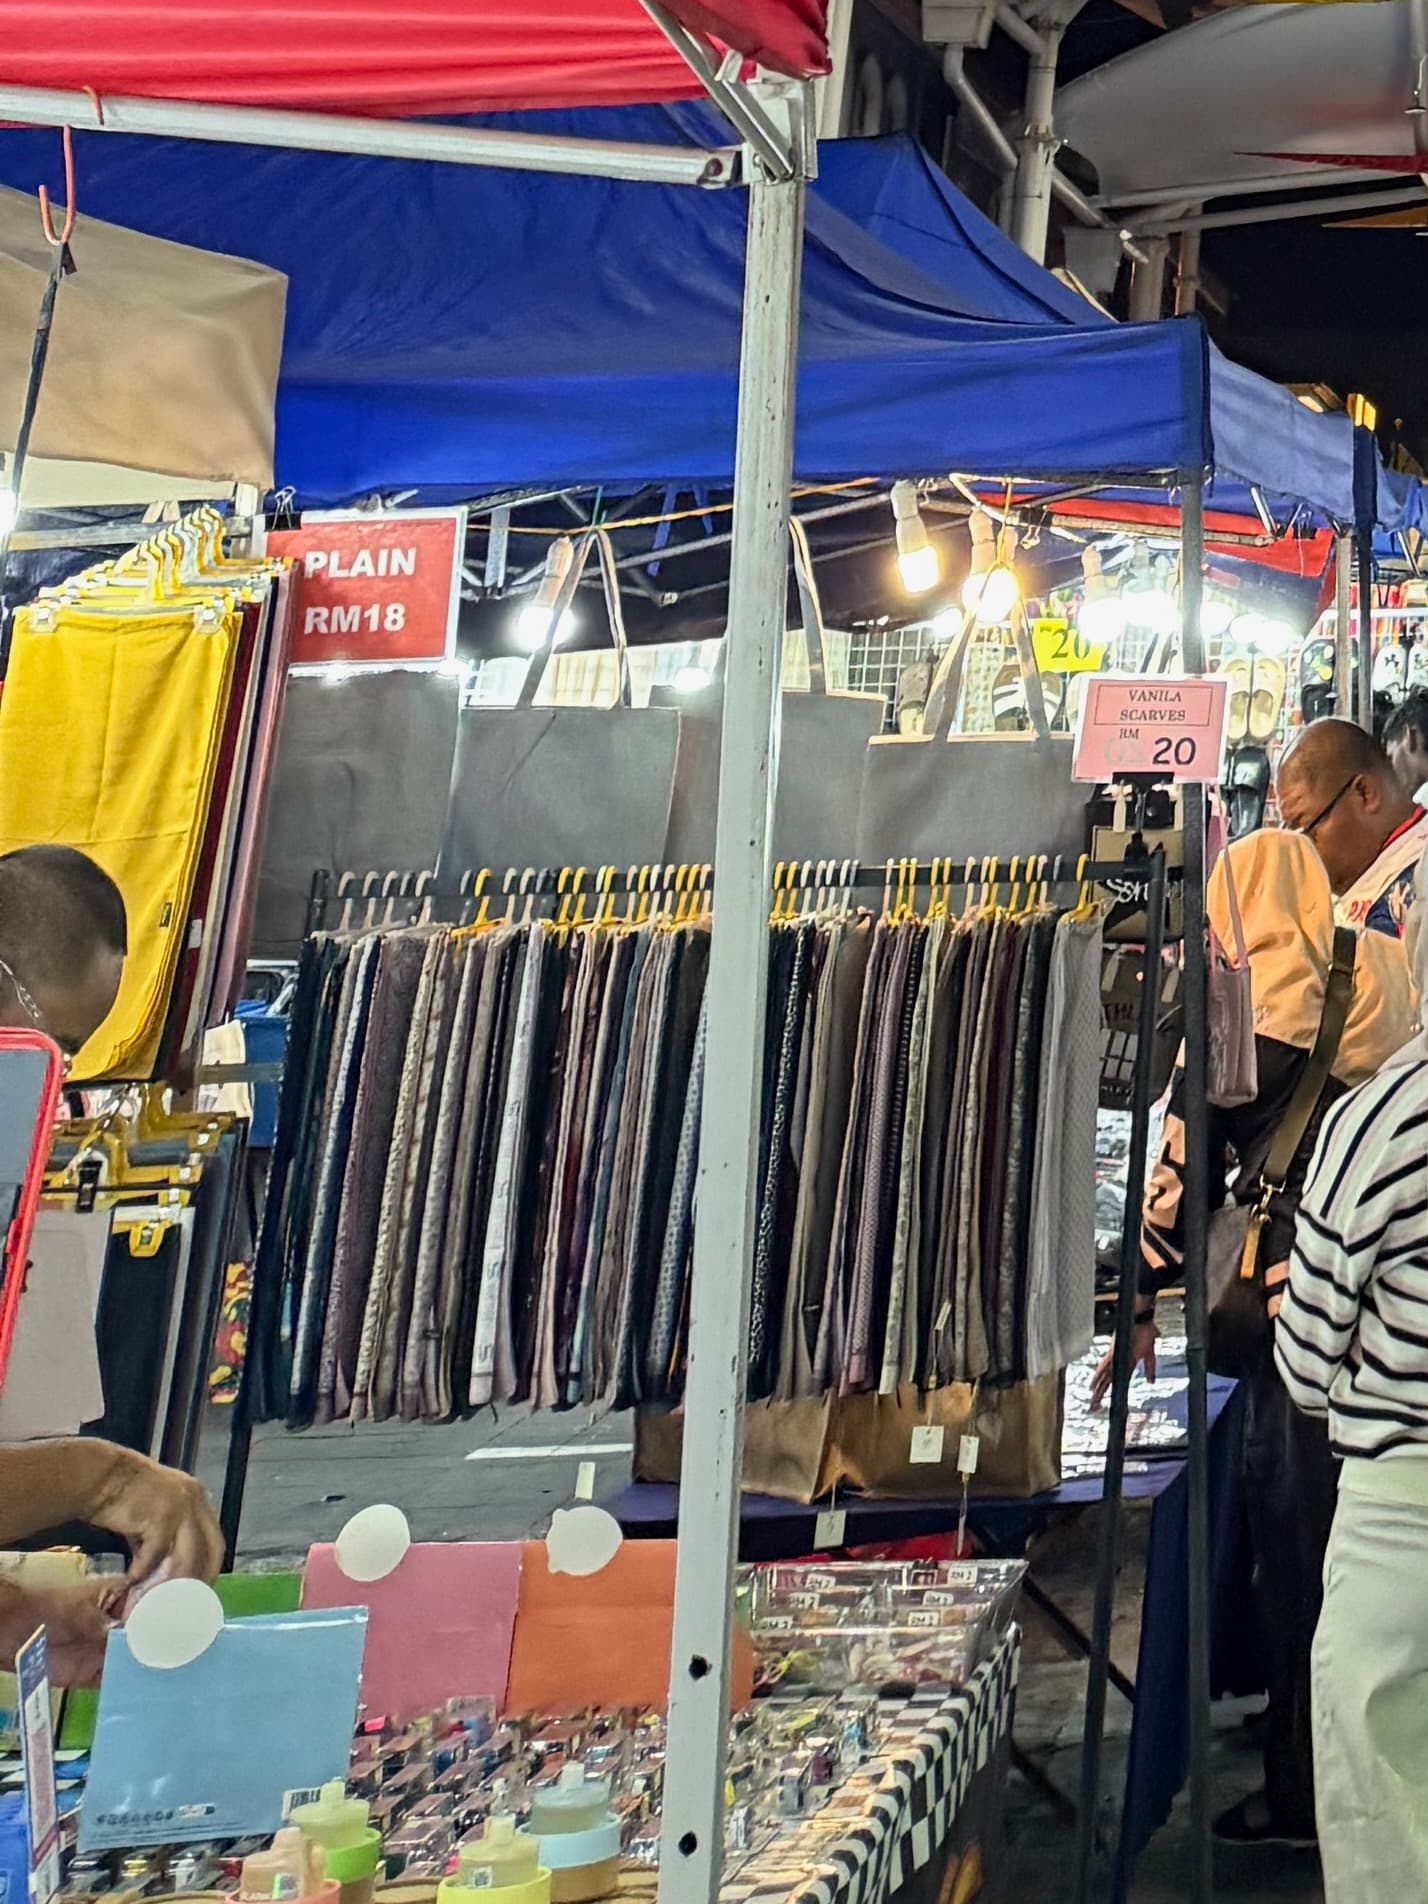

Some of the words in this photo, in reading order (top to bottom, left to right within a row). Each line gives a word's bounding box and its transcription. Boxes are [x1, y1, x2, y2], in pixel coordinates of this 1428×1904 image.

[304, 547, 417, 579] PLAIN
[304, 603, 406, 634] RM18
[1128, 689, 1182, 703] VANILA
[1119, 709, 1186, 722] SCARVES
[1152, 737, 1196, 766] 20
